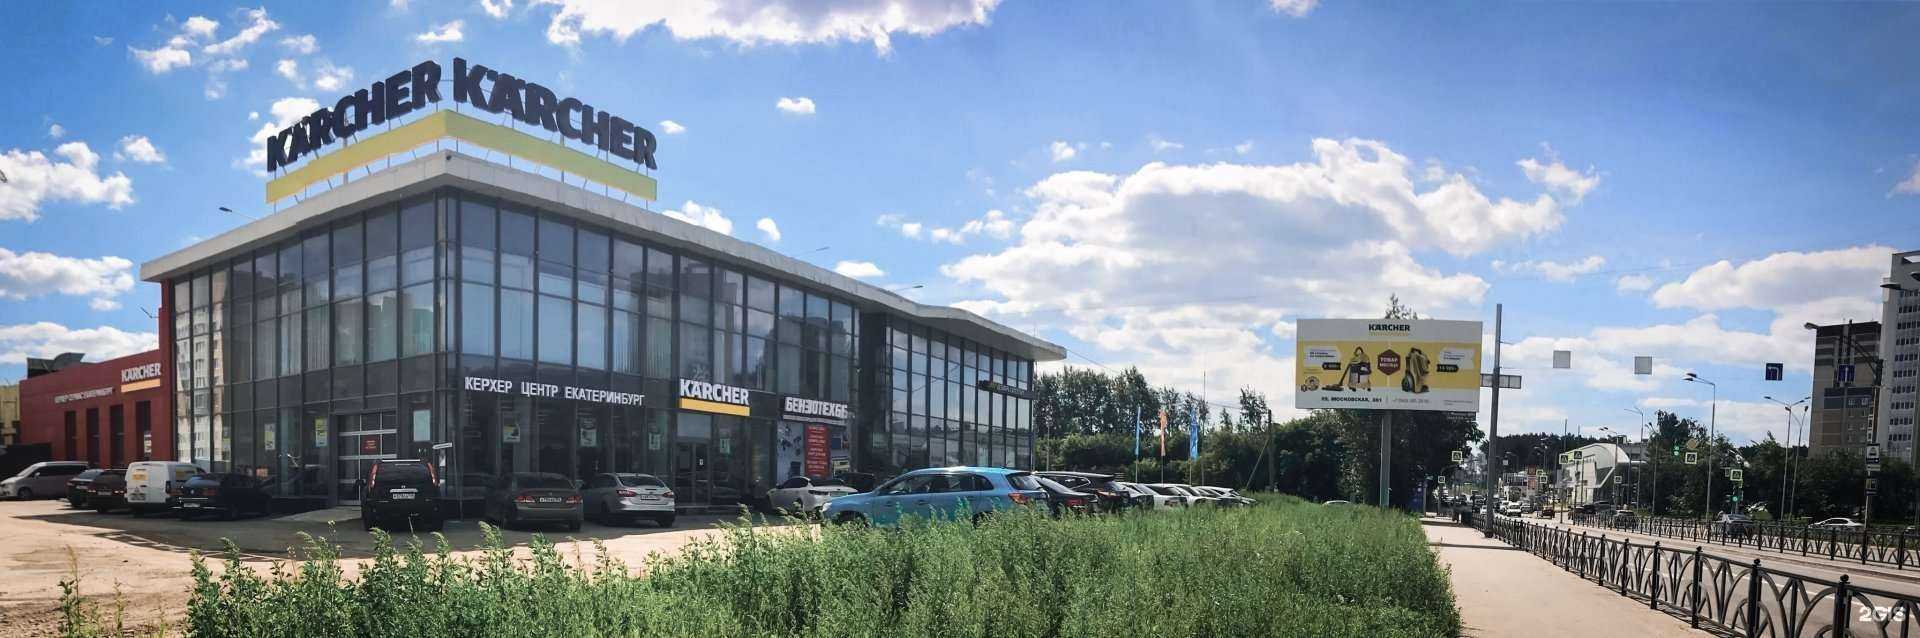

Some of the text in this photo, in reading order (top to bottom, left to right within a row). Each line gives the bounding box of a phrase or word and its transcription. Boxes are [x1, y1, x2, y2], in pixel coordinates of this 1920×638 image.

[452, 57, 658, 170] KÄRCHER
[464, 376, 645, 406] КЕРХЕР ЦЕНТР ЕКАТЕРИНБУРГ
[680, 378, 750, 405] KÄRCHER
